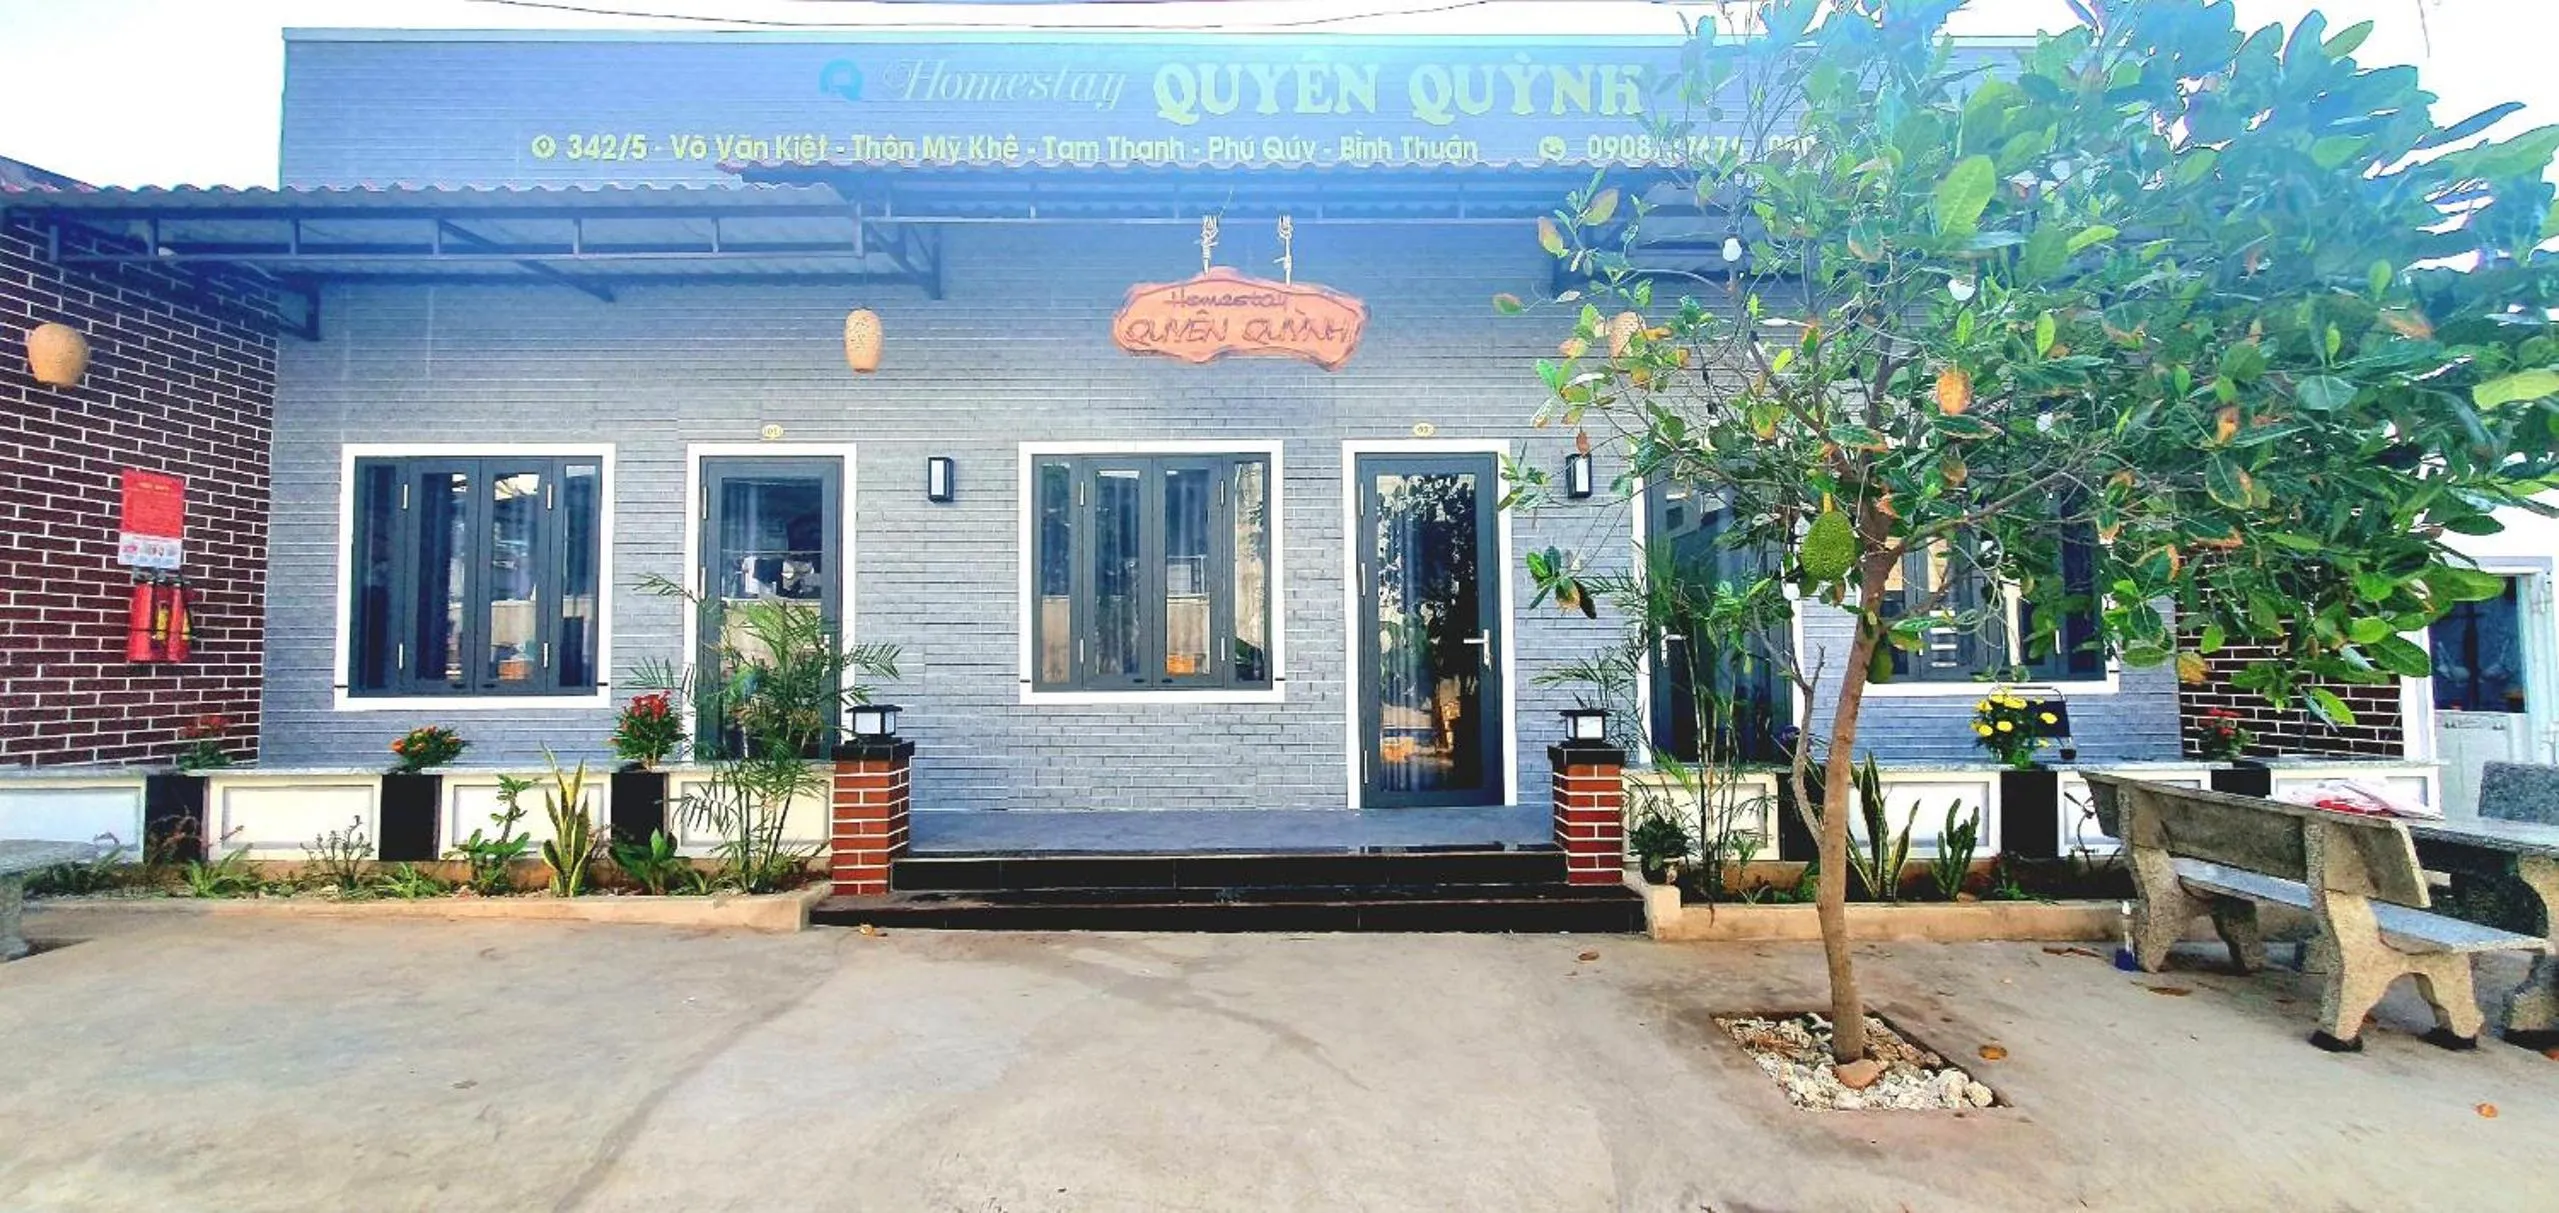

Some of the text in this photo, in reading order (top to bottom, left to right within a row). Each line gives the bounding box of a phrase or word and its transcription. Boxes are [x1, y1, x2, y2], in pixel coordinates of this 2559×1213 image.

[883, 51, 1646, 126] Homestay QUYÊN QUỲNH
[567, 133, 649, 161] 342/5
[669, 133, 708, 160] Võ
[775, 133, 829, 163] Kiệt
[851, 133, 914, 160] Thôn
[921, 134, 962, 163] Mỹ
[969, 133, 1020, 160] Khê
[1042, 135, 1100, 160] Tam
[1106, 135, 1185, 160] Thanh
[1208, 135, 1255, 161] Phú
[1340, 130, 1393, 161] Bình
[1125, 308, 1347, 346] QUYÊN QUỲNH
